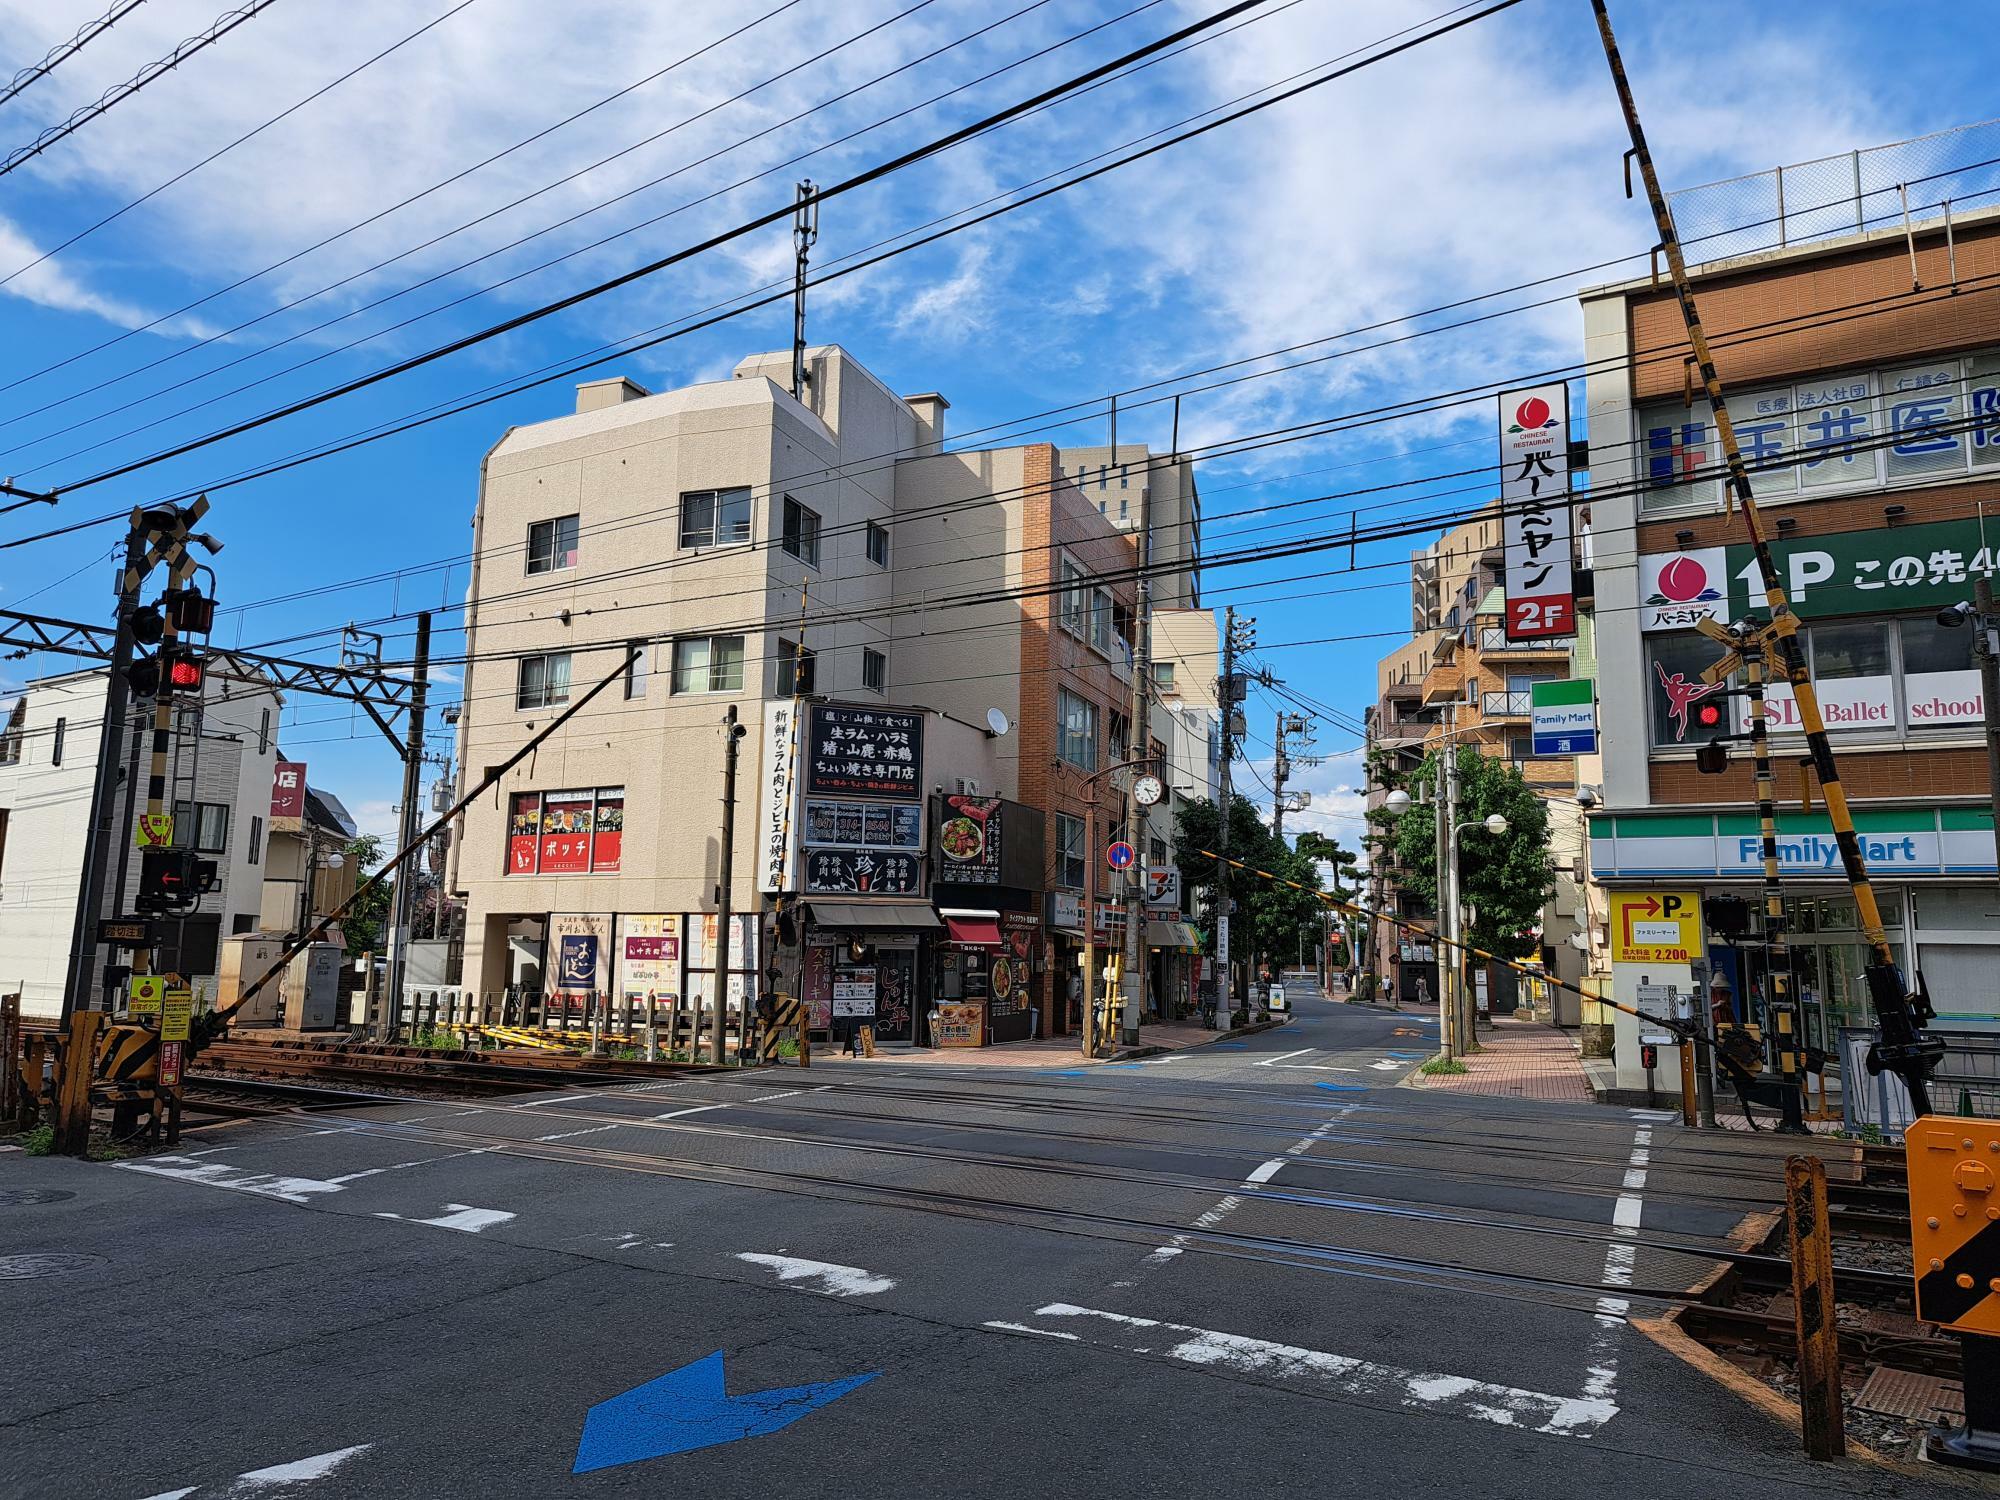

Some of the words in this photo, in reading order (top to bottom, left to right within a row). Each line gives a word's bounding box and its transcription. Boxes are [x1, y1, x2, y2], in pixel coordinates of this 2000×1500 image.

[1757, 397, 1789, 413] 医療
[1800, 384, 1866, 406] 法人社団
[1513, 438, 1555, 449] RESTAURANT
[1520, 430, 1548, 440] CHINESE
[1789, 551, 1835, 604] P
[1853, 547, 2000, 590] この先4
[1517, 602, 1563, 631] 2F
[1823, 701, 1889, 723] Ballet
[1911, 695, 1984, 718] school
[830, 725, 909, 745] 生ラム・ハラミ
[1558, 739, 1571, 752] 酒
[821, 740, 913, 762] 猪・山鹿・赤鶏
[815, 760, 916, 780] ちょい焼き専門店
[545, 840, 587, 857] ポッチ
[1662, 895, 1683, 918] P
[1622, 948, 1651, 956] 最大料金
[1655, 948, 1687, 960] 2,200
